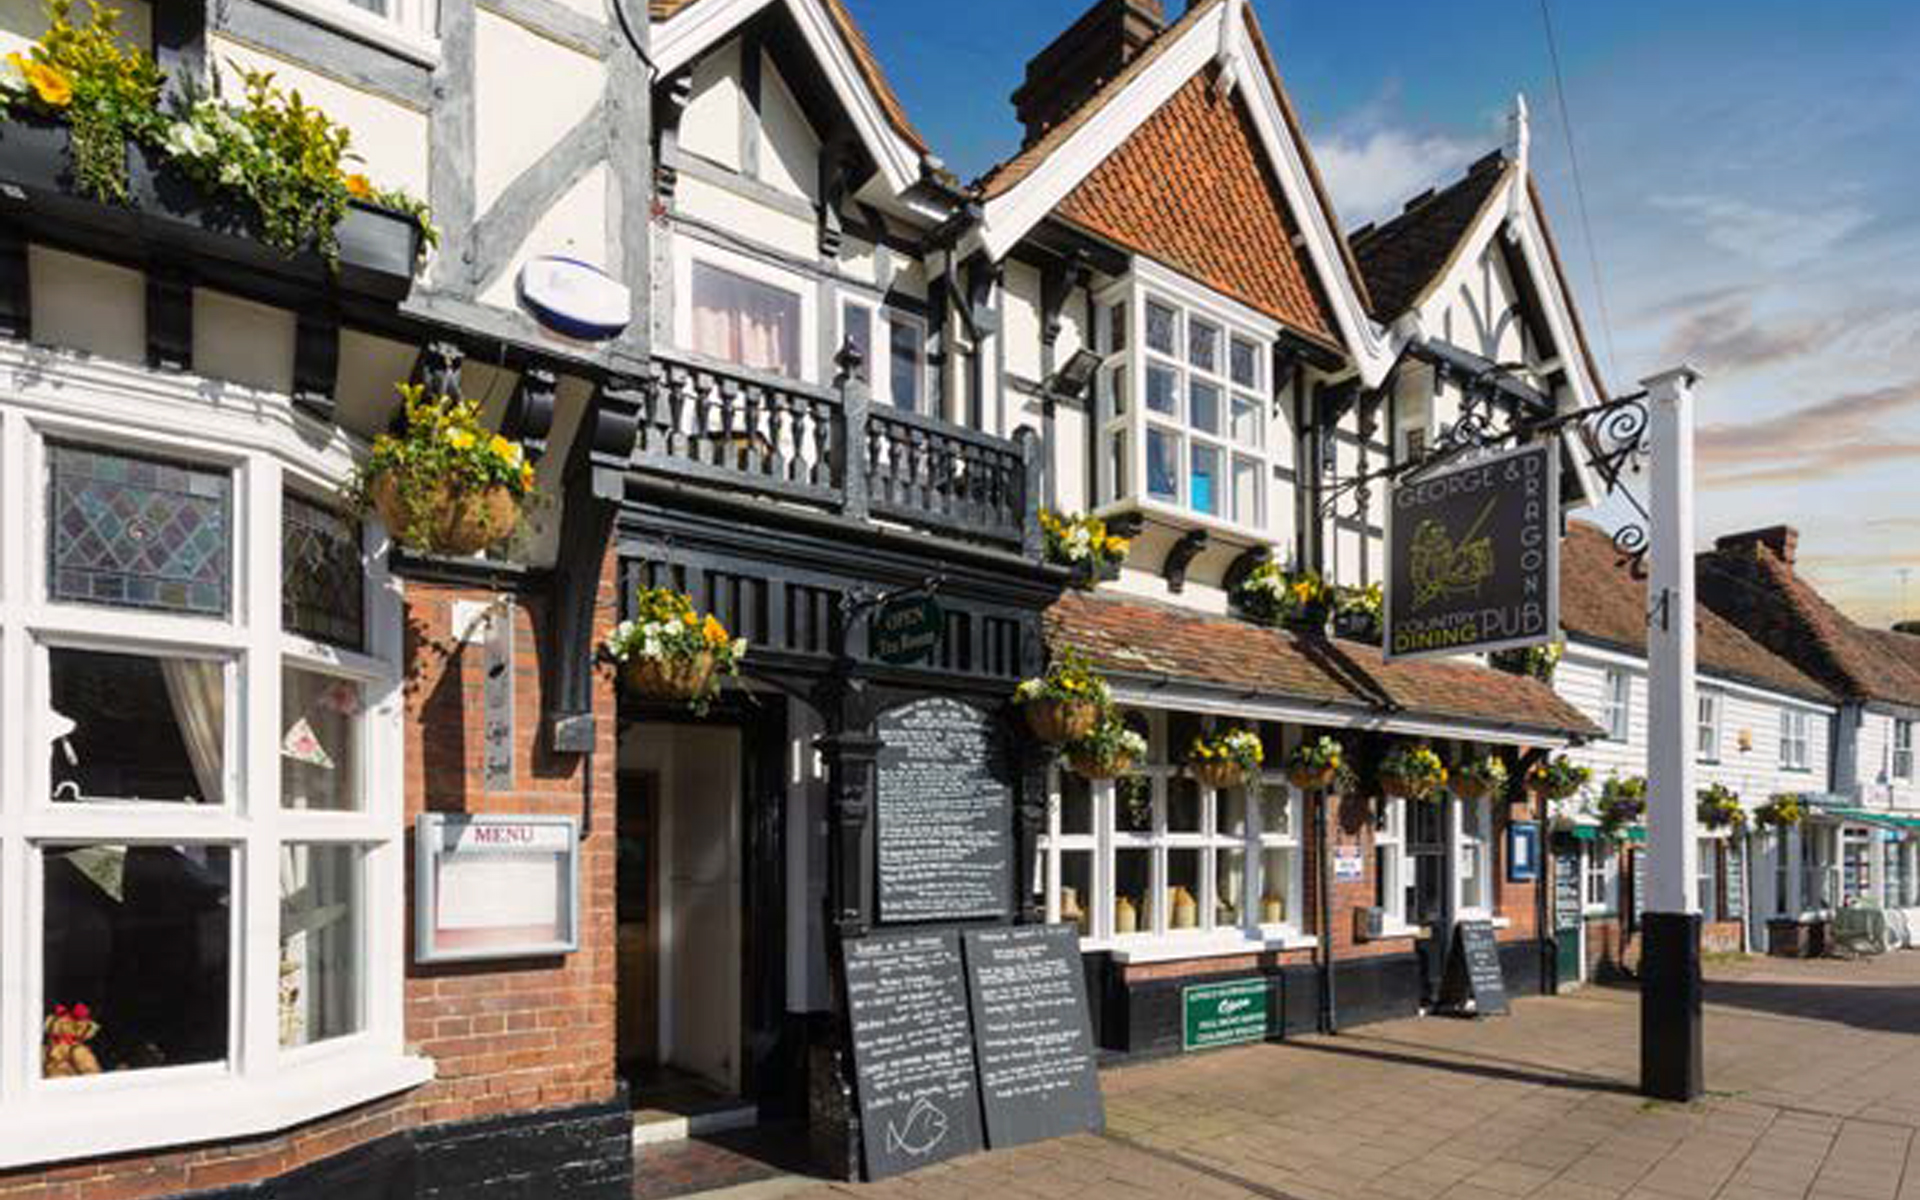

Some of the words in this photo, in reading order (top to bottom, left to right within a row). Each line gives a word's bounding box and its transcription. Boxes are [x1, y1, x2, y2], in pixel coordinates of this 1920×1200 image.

[1398, 465, 1494, 508] GEORGE
[1504, 459, 1520, 482] &
[1521, 457, 1543, 596] DRAGON
[1394, 624, 1476, 650] DINING
[1483, 603, 1543, 637] PUB
[474, 826, 534, 843] MENU
